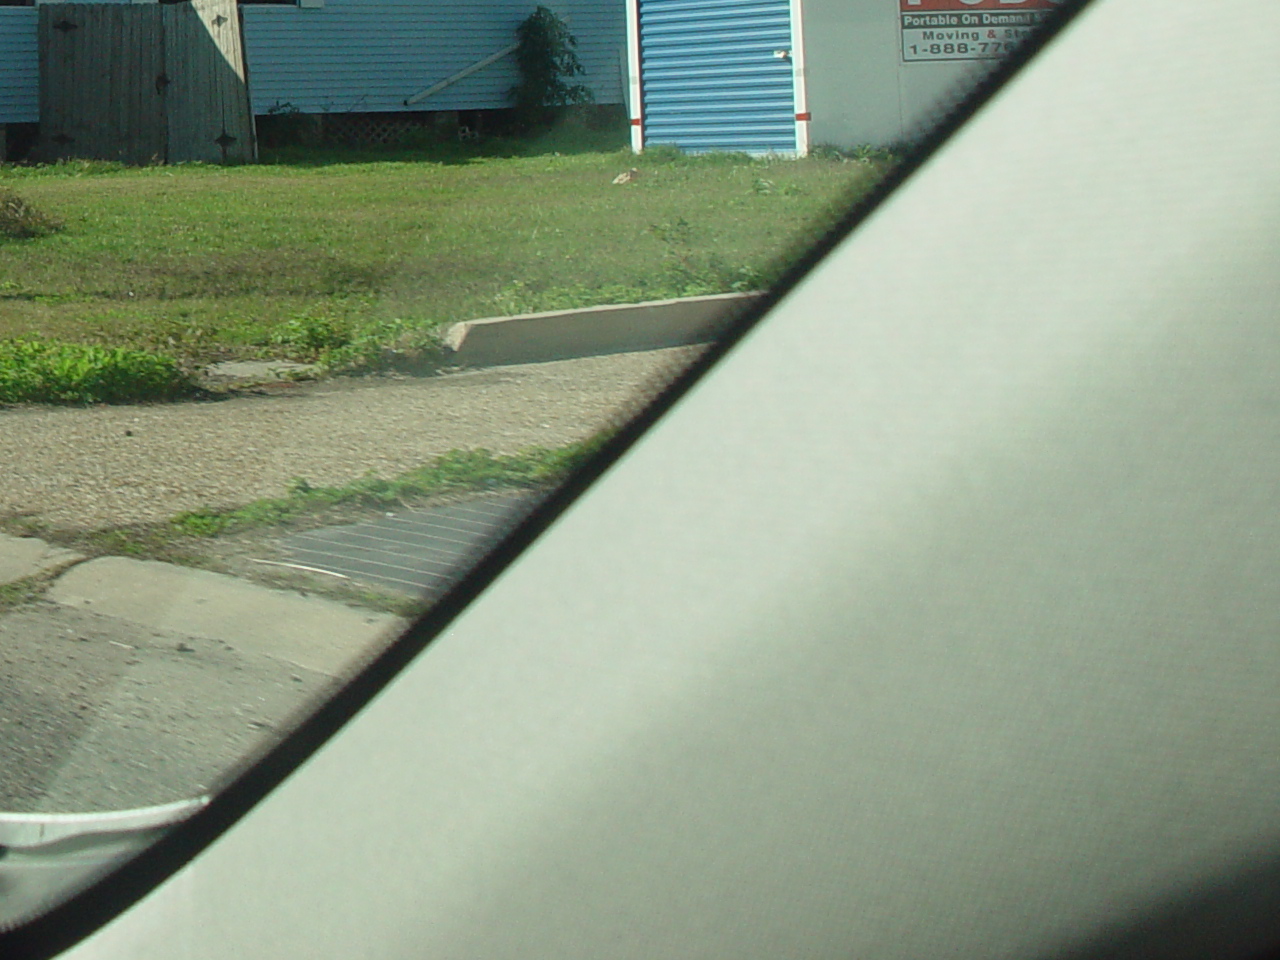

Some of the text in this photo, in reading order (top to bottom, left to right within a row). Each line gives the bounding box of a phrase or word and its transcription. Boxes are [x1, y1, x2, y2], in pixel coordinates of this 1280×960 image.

[904, 15, 958, 26] Portable
[961, 14, 979, 25] On
[982, 14, 1031, 24] Demand
[922, 31, 980, 41] Moving
[986, 29, 997, 39] &
